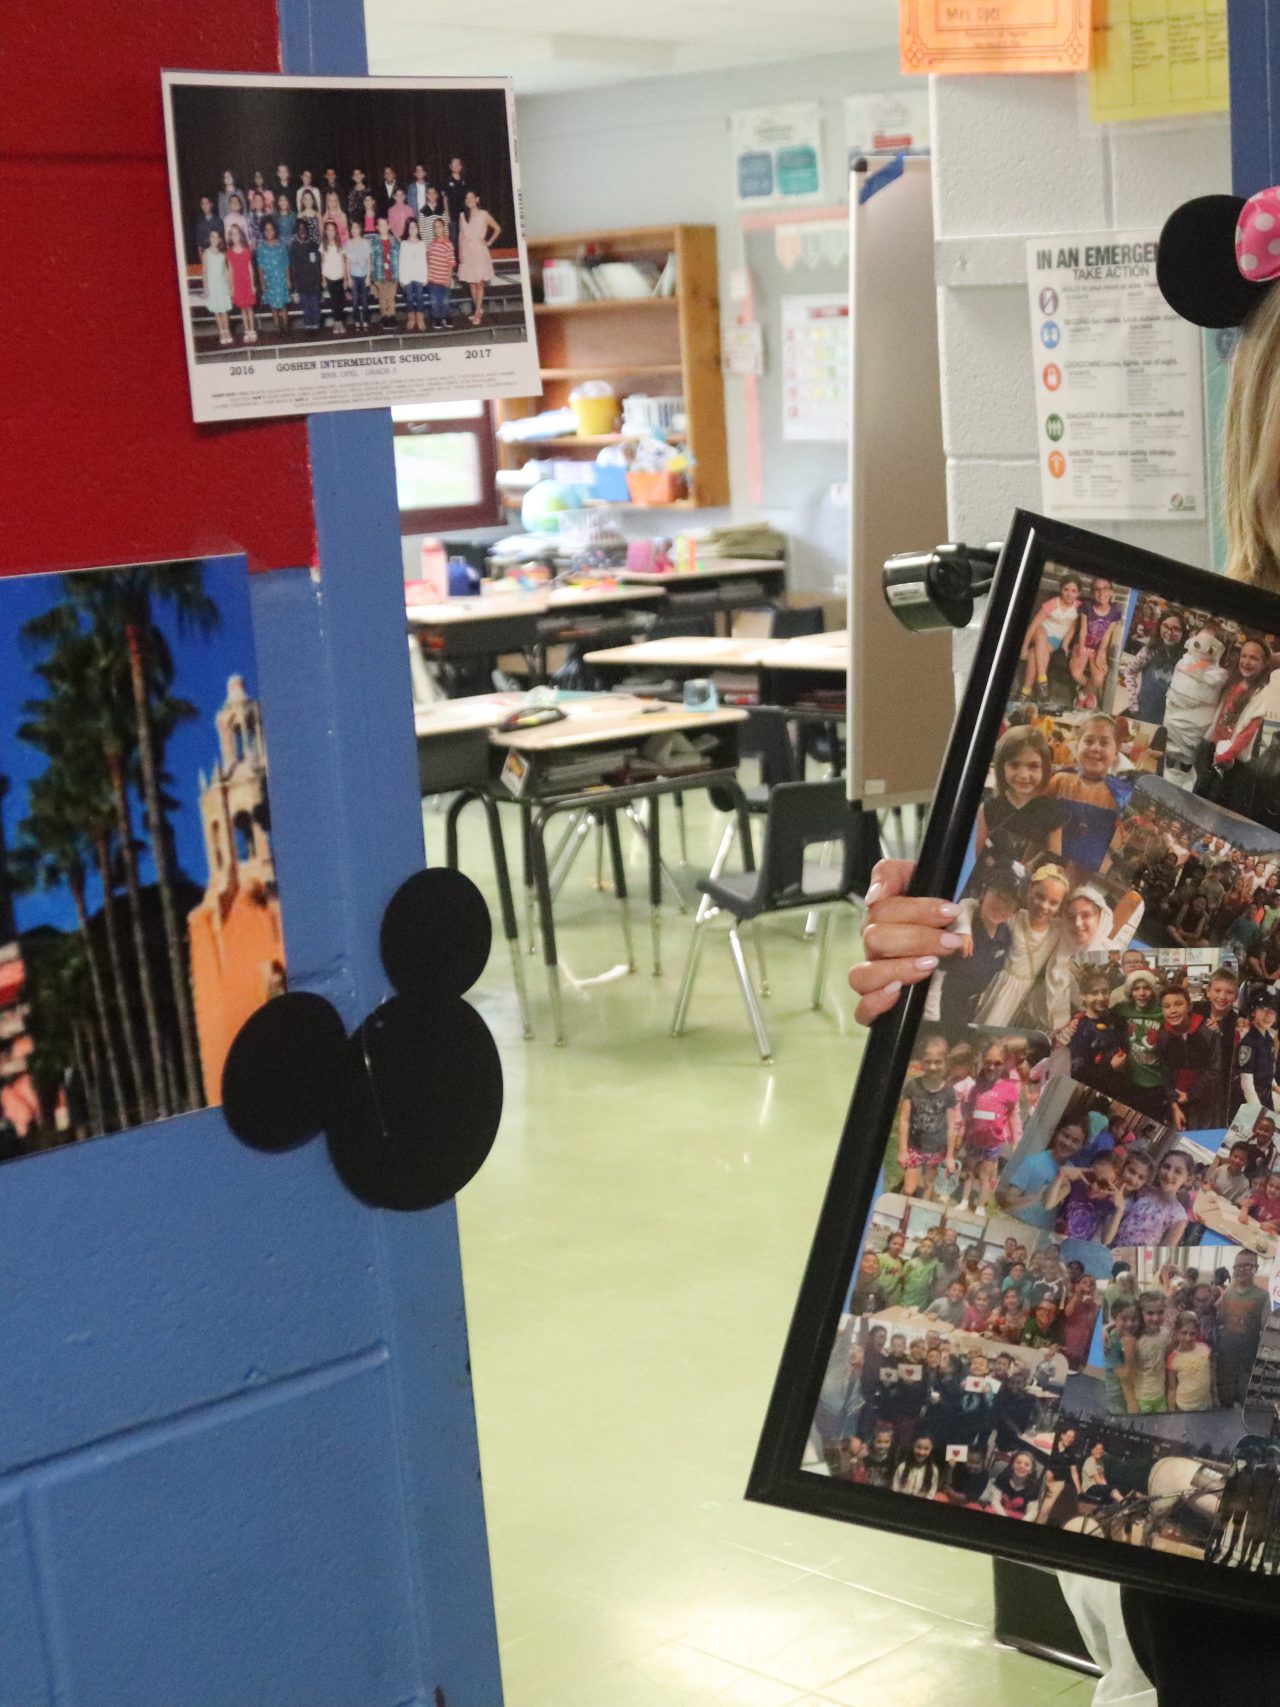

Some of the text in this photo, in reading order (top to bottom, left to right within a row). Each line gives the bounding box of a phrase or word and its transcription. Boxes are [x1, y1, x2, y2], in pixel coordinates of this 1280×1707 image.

[1036, 249, 1053, 270] IN
[1056, 246, 1079, 269] AN
[1073, 264, 1150, 280] TAKE ACTION
[229, 348, 491, 376] 2016 GOSHEN INTERMEDIATE SCHOOL 2017
